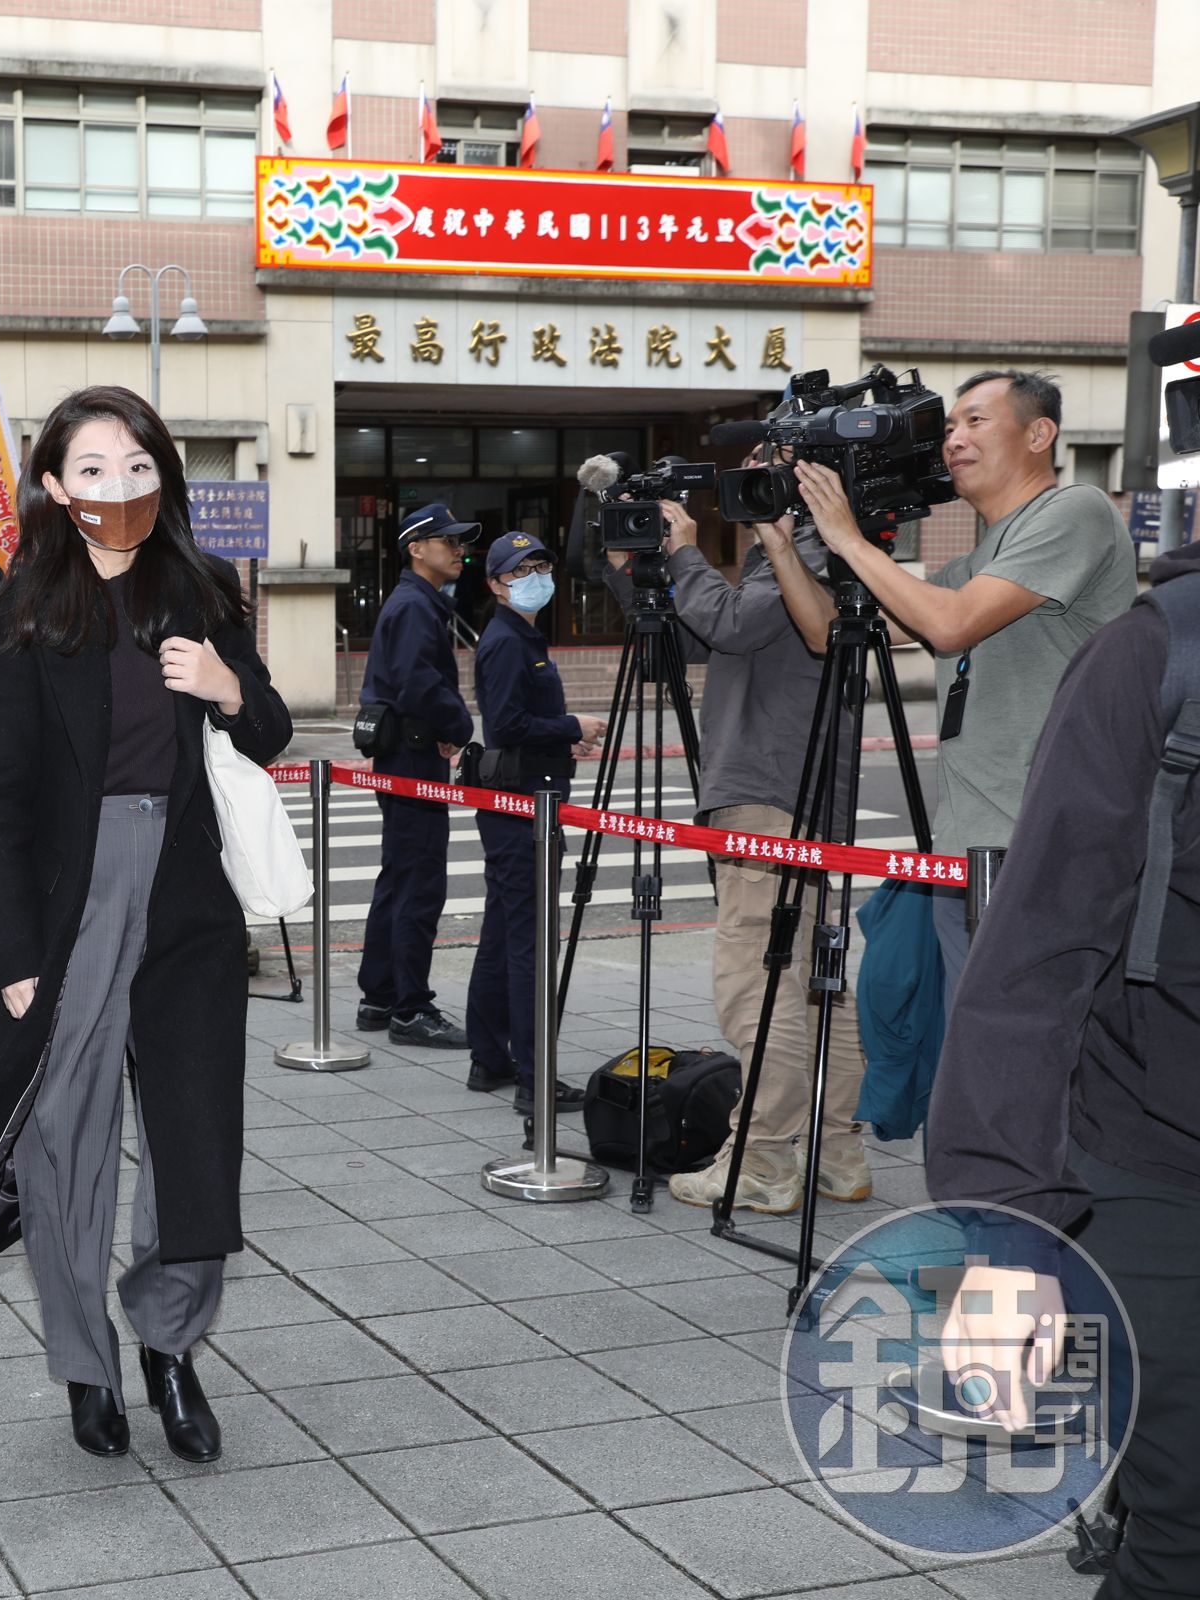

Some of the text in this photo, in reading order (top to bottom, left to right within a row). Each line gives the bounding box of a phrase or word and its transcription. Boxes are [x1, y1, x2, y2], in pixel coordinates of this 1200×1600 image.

[412, 206, 736, 244] 慶祝中華民國113年元旦
[345, 312, 793, 372] 最高行政法院大廈
[599, 813, 675, 842] 臺灣臺北地方法院
[725, 834, 823, 865] 臺灣臺北地方法院
